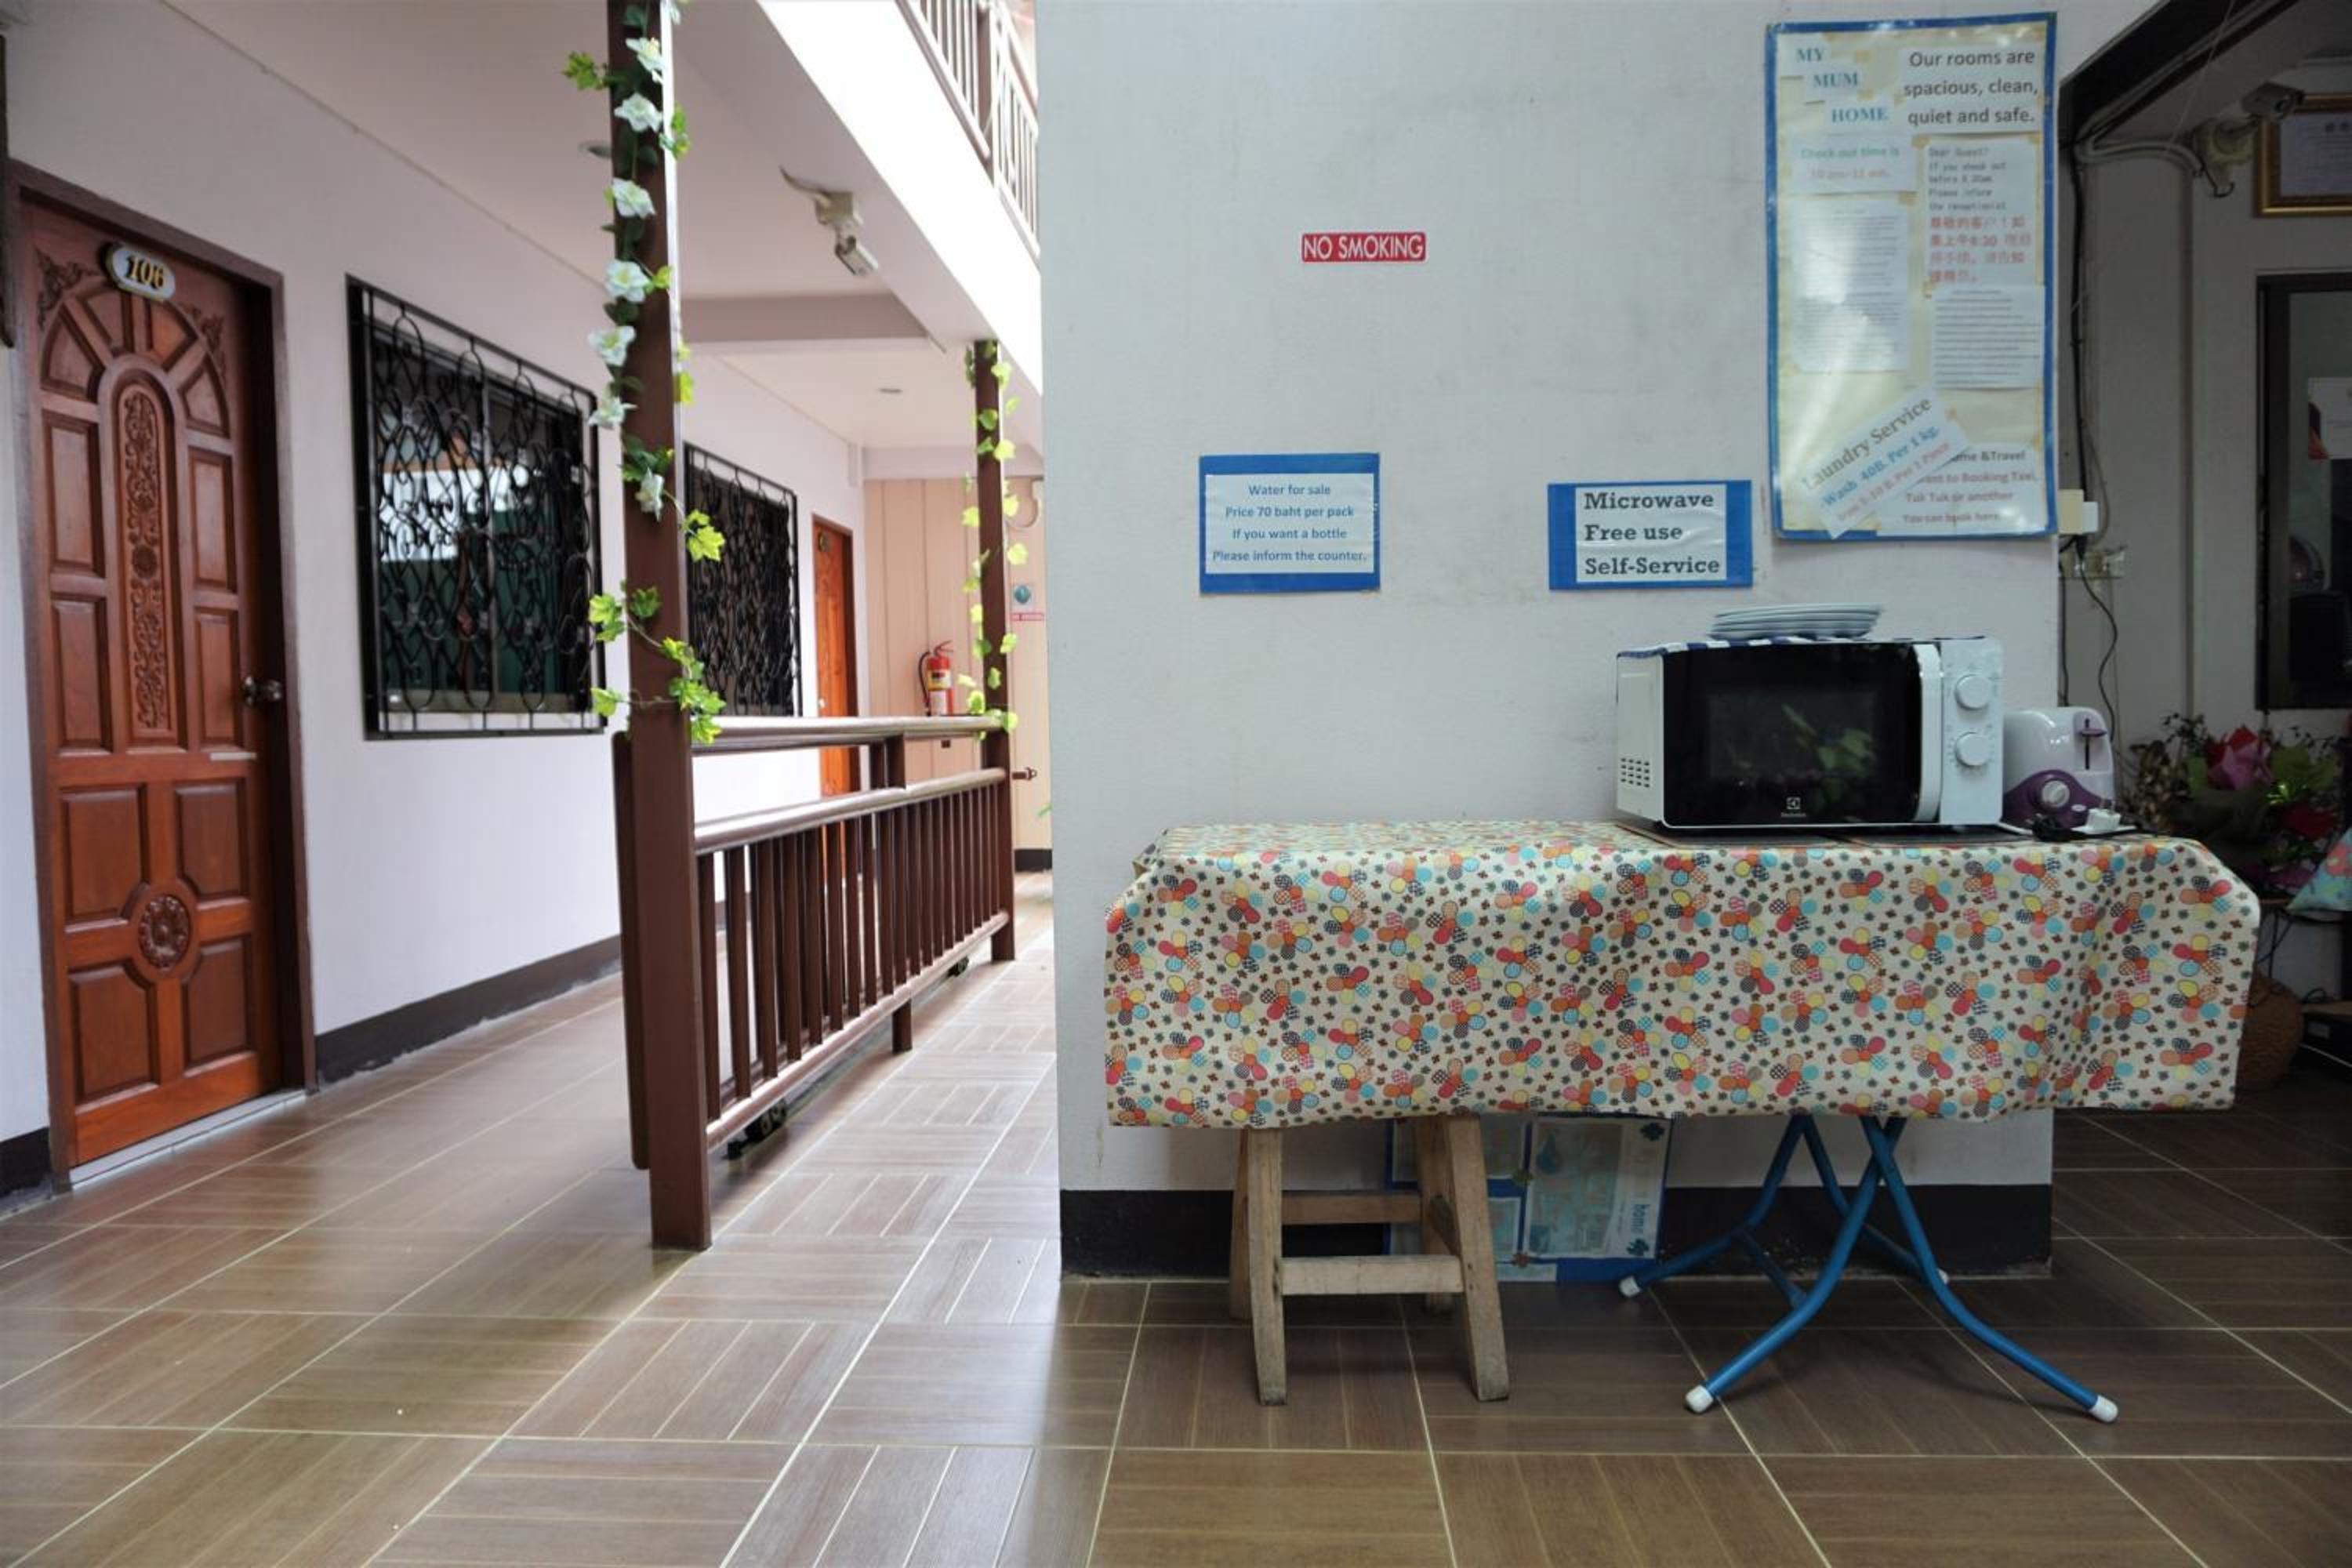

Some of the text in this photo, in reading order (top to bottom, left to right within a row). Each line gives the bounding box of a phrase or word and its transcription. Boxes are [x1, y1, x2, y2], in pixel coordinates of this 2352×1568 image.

[1796, 48, 1824, 62] MY
[1910, 50, 2035, 67] Our rooms are
[1813, 73, 1858, 88] MUM
[1904, 78, 2038, 100] spacious, clean,
[1831, 107, 1889, 123] HOME
[1908, 107, 2035, 127] quiet and safe.
[1304, 234, 1423, 260] NO SMOKING
[1871, 398, 1932, 445] Service
[1248, 484, 1330, 495] Water for sale
[1584, 492, 1715, 510] Microwave
[1225, 506, 1354, 519] Price 70 baht per pack
[1232, 528, 1241, 539] If
[1244, 531, 1266, 540] you
[1268, 529, 1298, 539] want
[1312, 528, 1348, 539] bottle
[1584, 524, 1683, 541] Free use
[1213, 550, 1367, 561] Please inform the counter.
[1584, 557, 1720, 575] Self-Service
